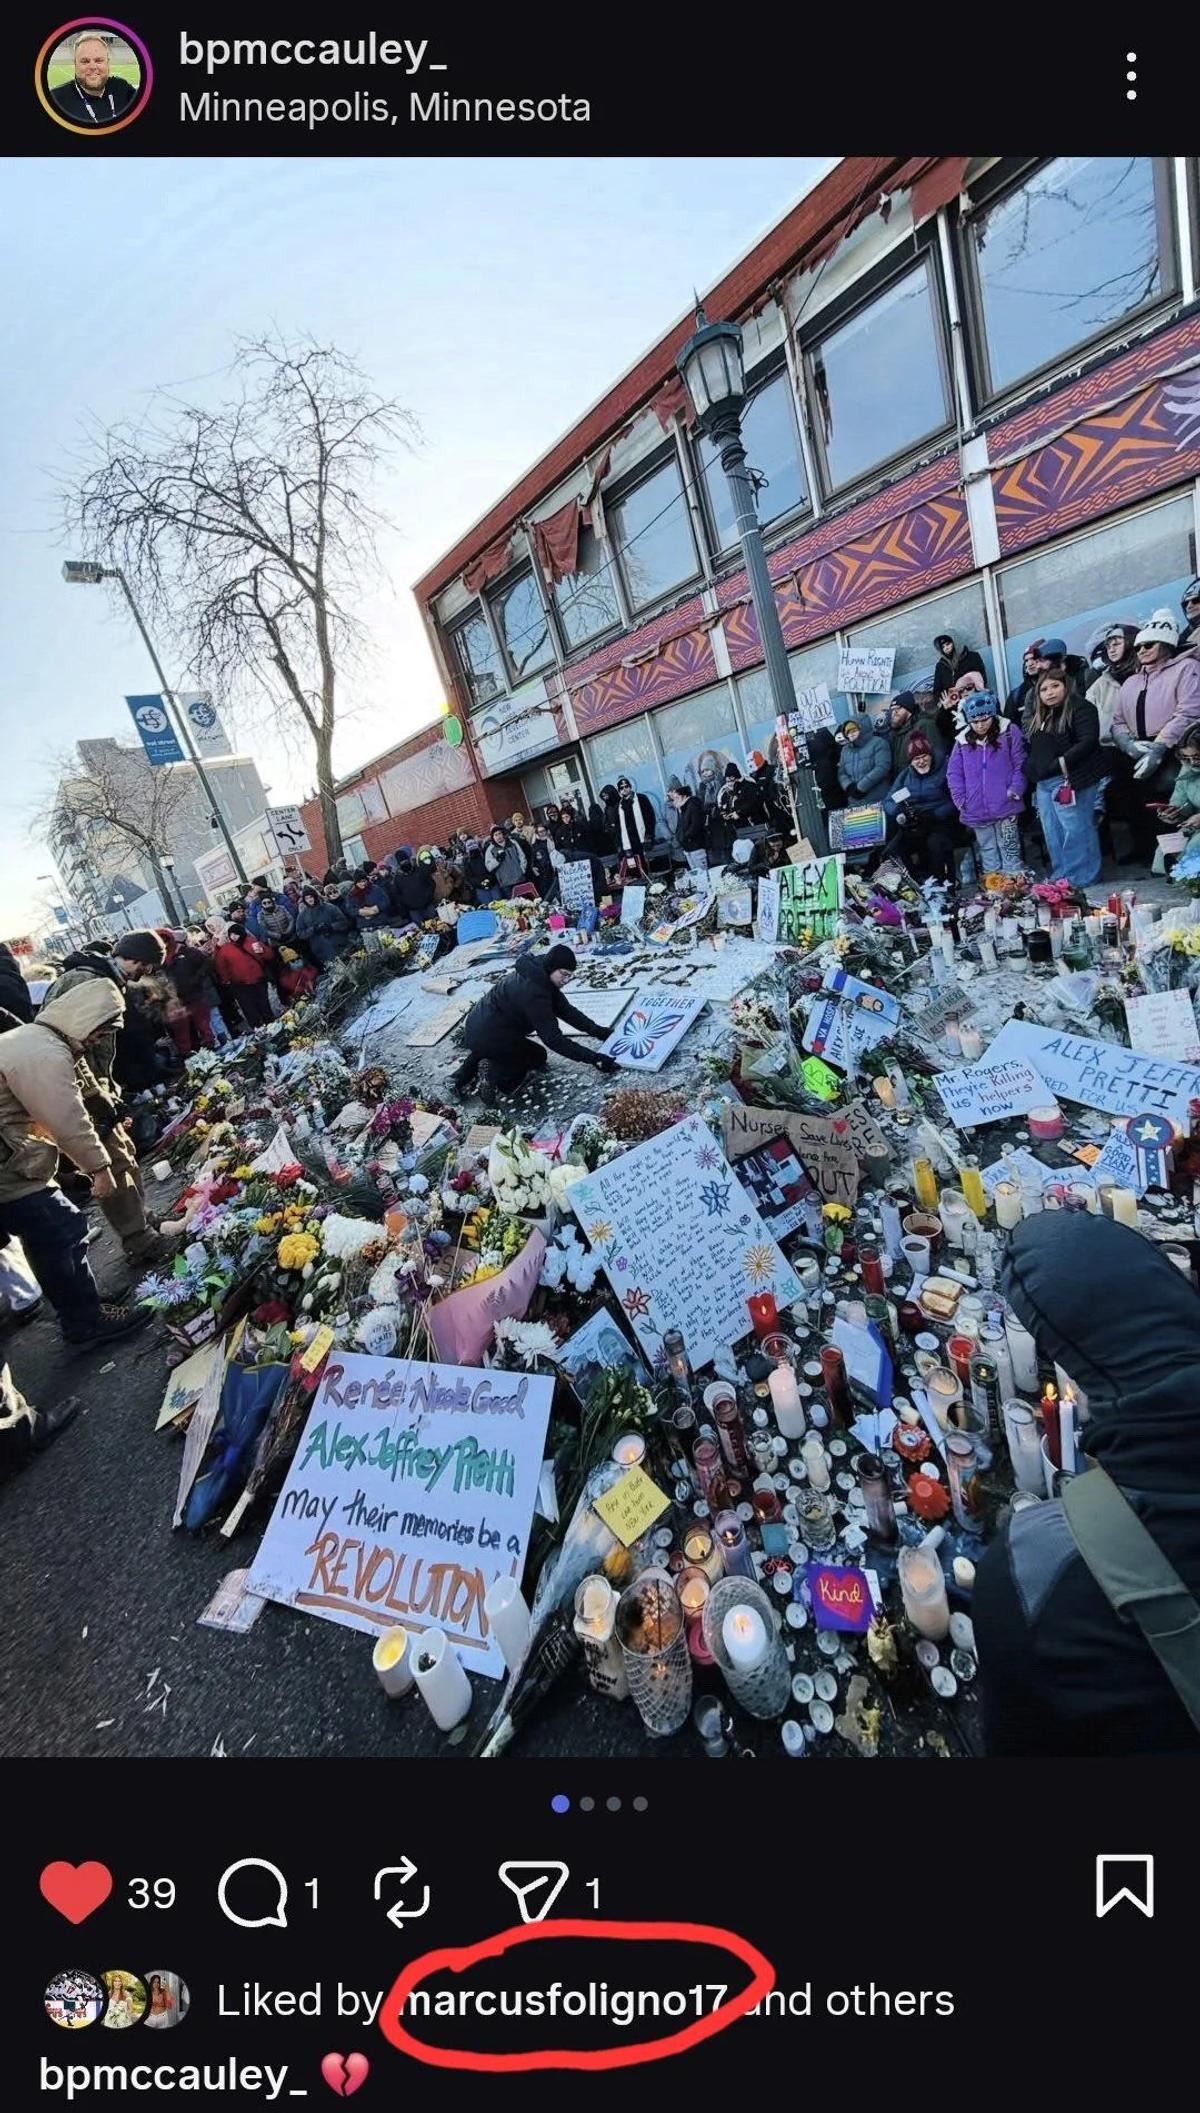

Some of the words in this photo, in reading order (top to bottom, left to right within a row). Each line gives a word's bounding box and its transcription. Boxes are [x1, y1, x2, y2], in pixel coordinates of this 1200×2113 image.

[271, 807, 296, 816] CENTER
[276, 814, 294, 822] LANE
[780, 862, 829, 903] ALEX
[640, 996, 696, 1011] TOGETHER
[817, 1027, 829, 1042] VA
[1041, 1038, 1106, 1066] ALEX
[962, 1058, 1023, 1082] Rogers,
[992, 1067, 1035, 1088] Killing
[951, 1100, 972, 1111] us
[978, 1082, 1033, 1105] helpers
[1078, 1066, 1177, 1110] PRETTI
[1078, 1090, 1107, 1107] FOR
[979, 1101, 1015, 1118] now
[731, 1110, 789, 1137] Nurses
[800, 1123, 826, 1142] Save
[1103, 1154, 1135, 1176] MAN!
[1104, 1145, 1133, 1163] GOOD
[322, 1363, 404, 1410] Renée
[471, 1376, 528, 1420] Good
[299, 1420, 369, 1472] Alex
[367, 1424, 449, 1493] Jeffrey
[343, 1488, 398, 1533] their
[400, 1511, 475, 1547] memories
[477, 1517, 502, 1547] be
[507, 1535, 521, 1554] a
[819, 1577, 864, 1603] Kind
